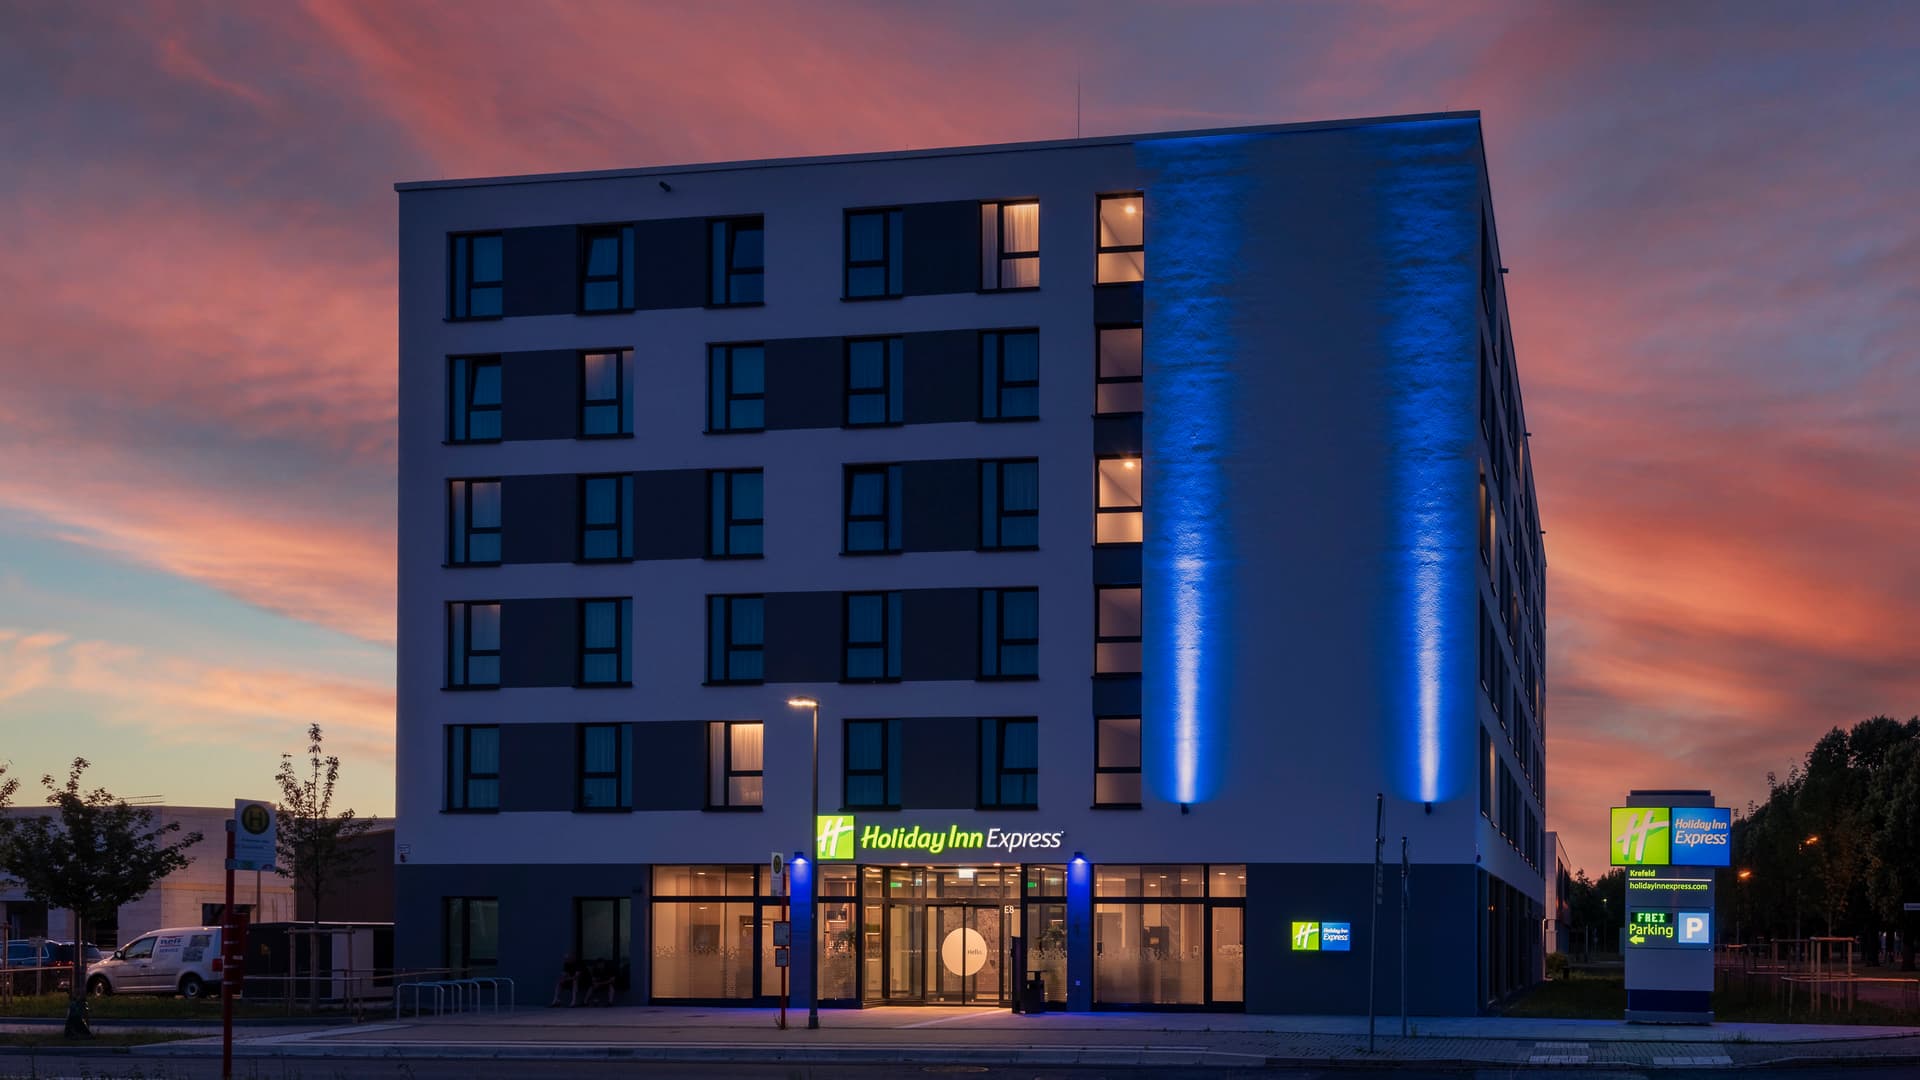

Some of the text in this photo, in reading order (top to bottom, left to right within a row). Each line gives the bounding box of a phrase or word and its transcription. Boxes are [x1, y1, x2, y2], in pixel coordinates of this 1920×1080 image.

[1674, 818, 1727, 831] Holiday Inn
[861, 824, 1062, 854] Holiday Inn Express
[1674, 830, 1727, 848] Express
[1629, 869, 1656, 877] Krefeld
[1629, 882, 1708, 891] holidayinnexpress.com
[1004, 905, 1015, 914] E8
[1323, 927, 1340, 935] Holiday
[1629, 923, 1674, 938] Parking
[1686, 917, 1703, 939] P
[1323, 934, 1349, 942] Express
